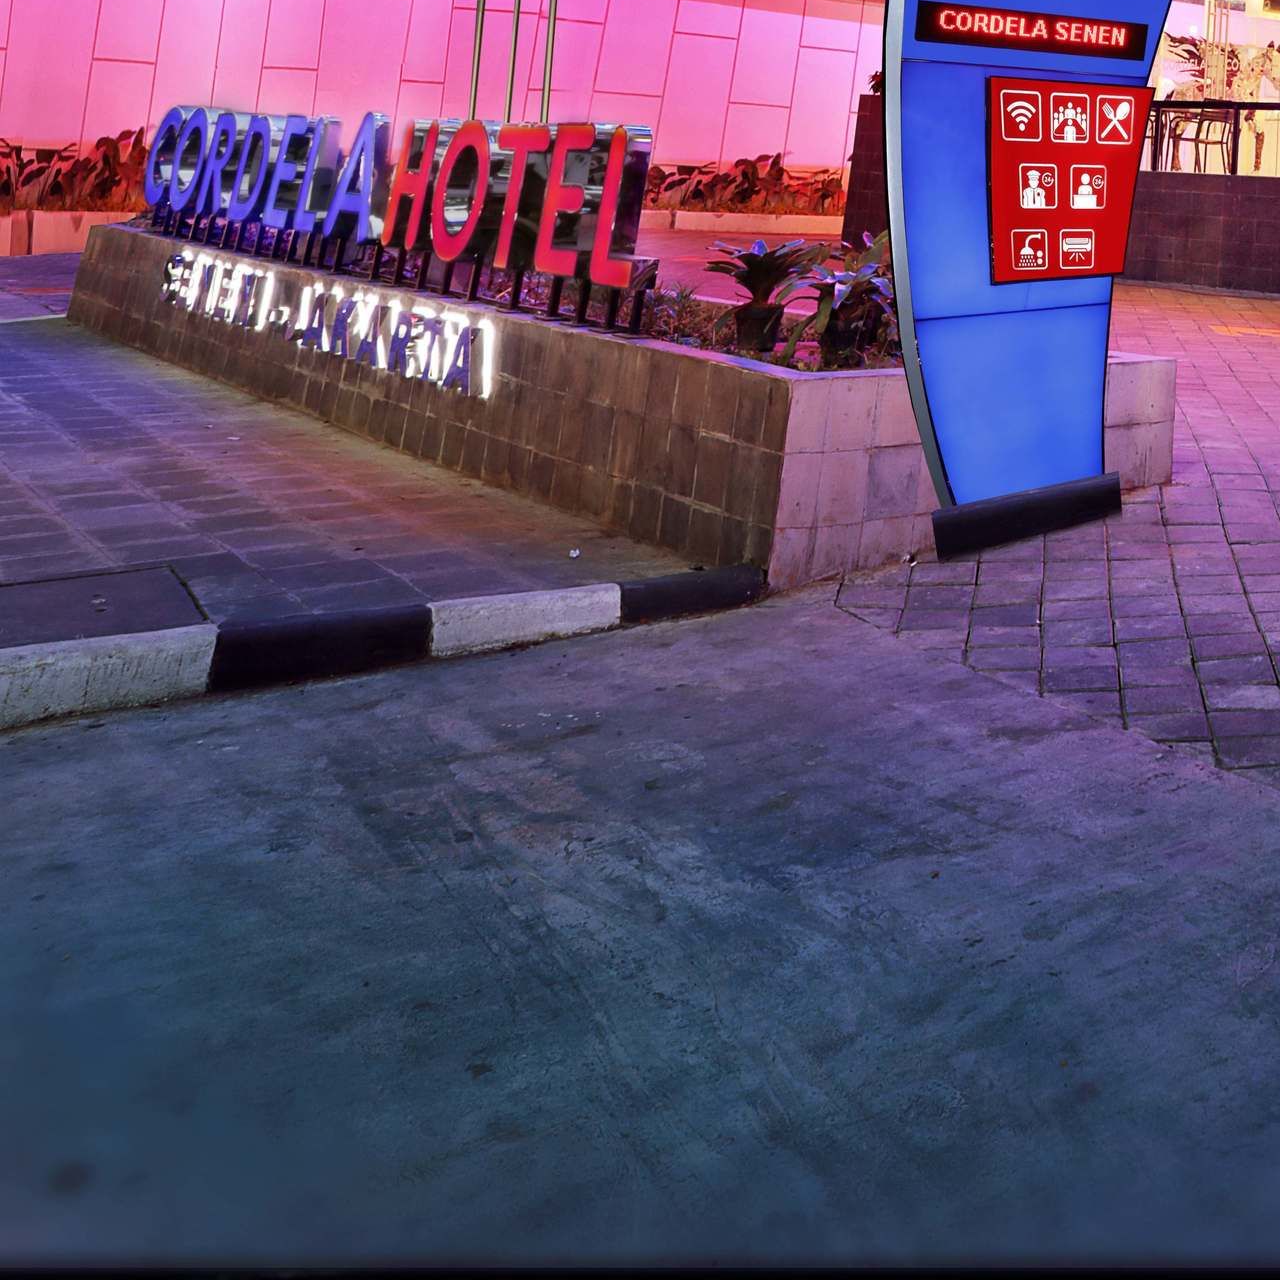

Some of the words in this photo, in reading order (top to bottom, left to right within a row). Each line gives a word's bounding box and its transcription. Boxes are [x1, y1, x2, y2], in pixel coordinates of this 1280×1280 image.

[939, 9, 1048, 39] CORDELA
[1054, 21, 1126, 46] SENEN
[144, 105, 379, 243] CORDELA
[381, 119, 642, 288] HOTEL
[284, 286, 484, 397] JAKARTA
